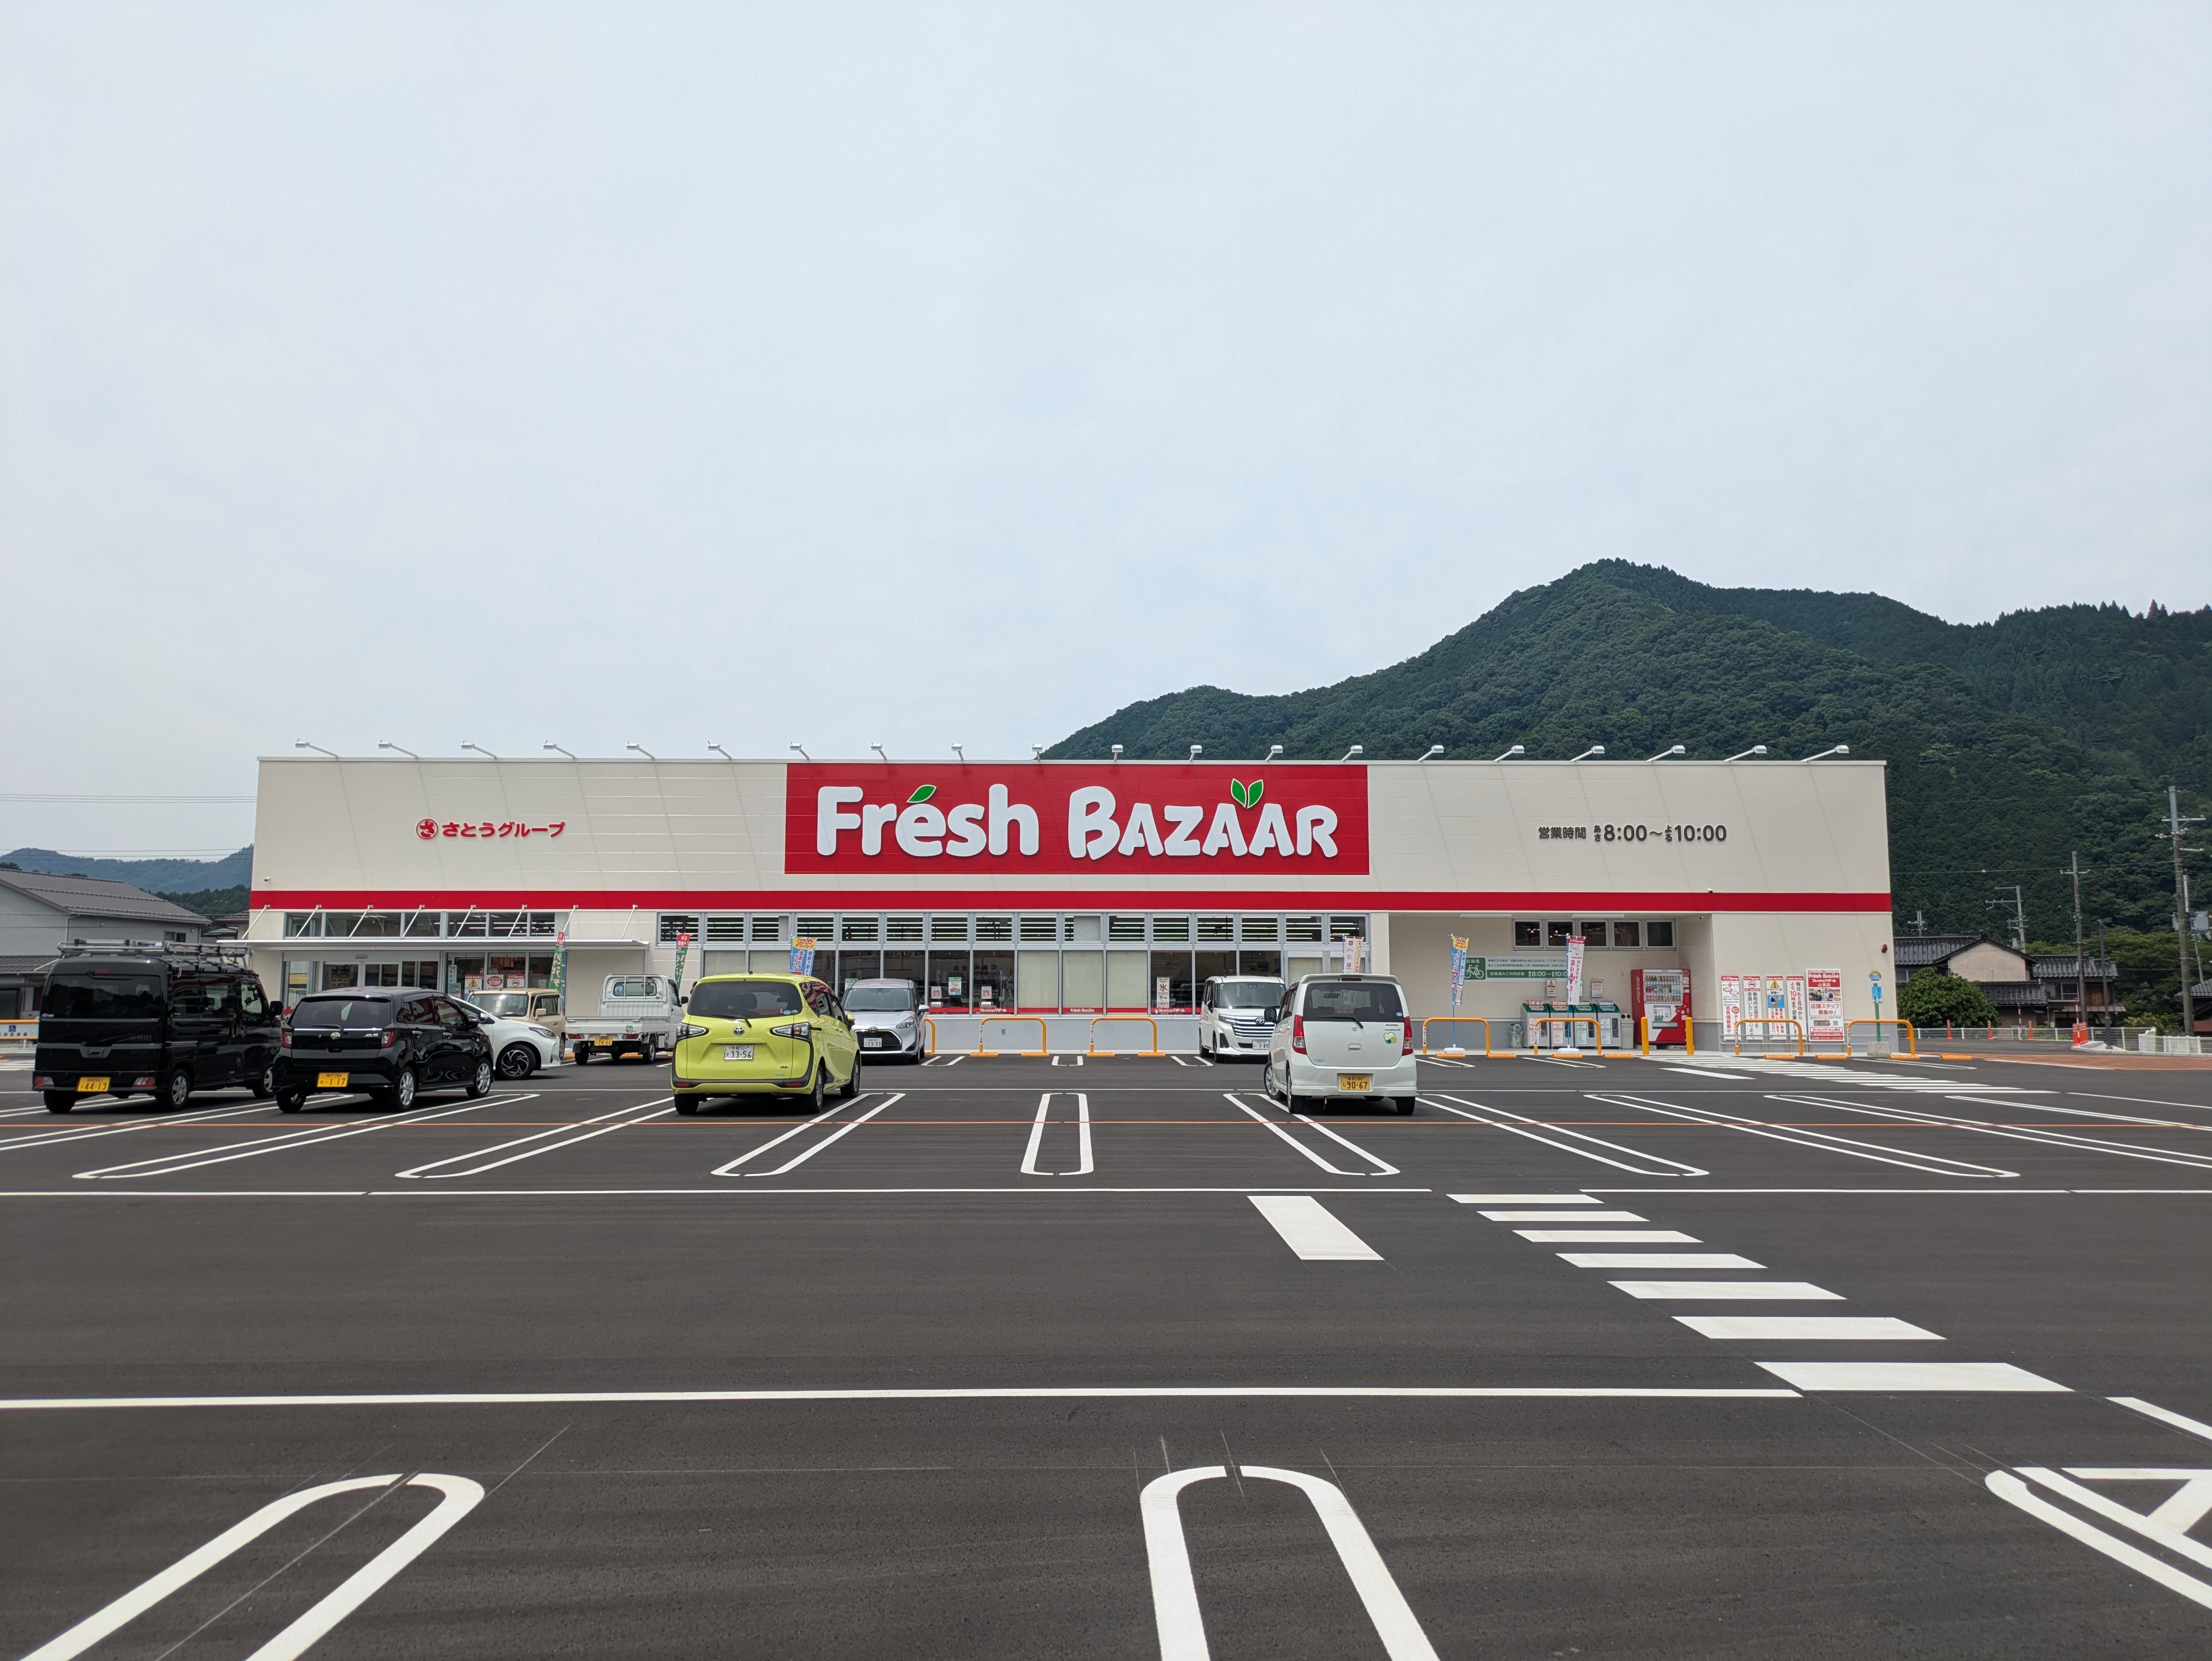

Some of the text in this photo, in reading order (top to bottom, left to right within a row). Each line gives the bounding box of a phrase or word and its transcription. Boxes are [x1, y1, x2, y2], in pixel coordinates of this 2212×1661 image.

[442, 821, 565, 837] さとうグループ
[817, 784, 1338, 860] Fresh BAZAAR
[1538, 827, 1586, 839] 営業時間
[1159, 984, 1167, 992] 氷
